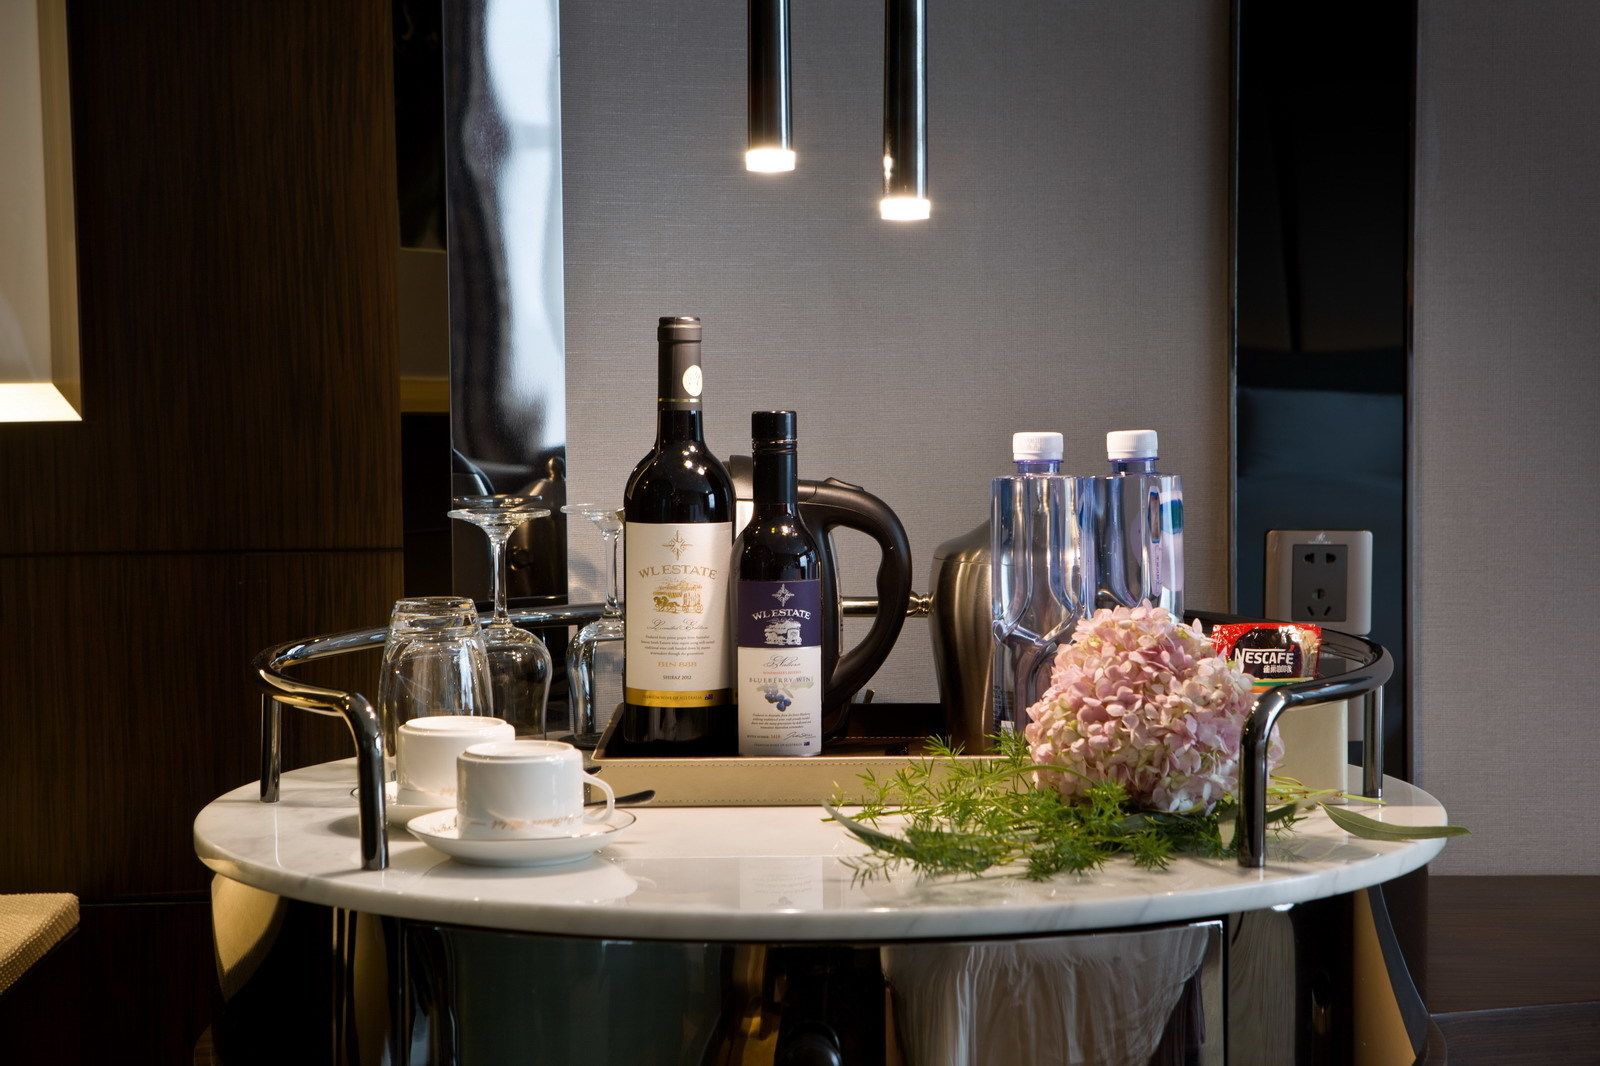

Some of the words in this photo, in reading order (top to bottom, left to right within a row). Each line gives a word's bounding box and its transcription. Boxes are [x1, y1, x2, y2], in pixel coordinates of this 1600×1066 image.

[639, 566, 660, 578] WL
[662, 565, 717, 579] ESTATE
[752, 610, 771, 620] WL
[771, 608, 811, 620] ESTATE
